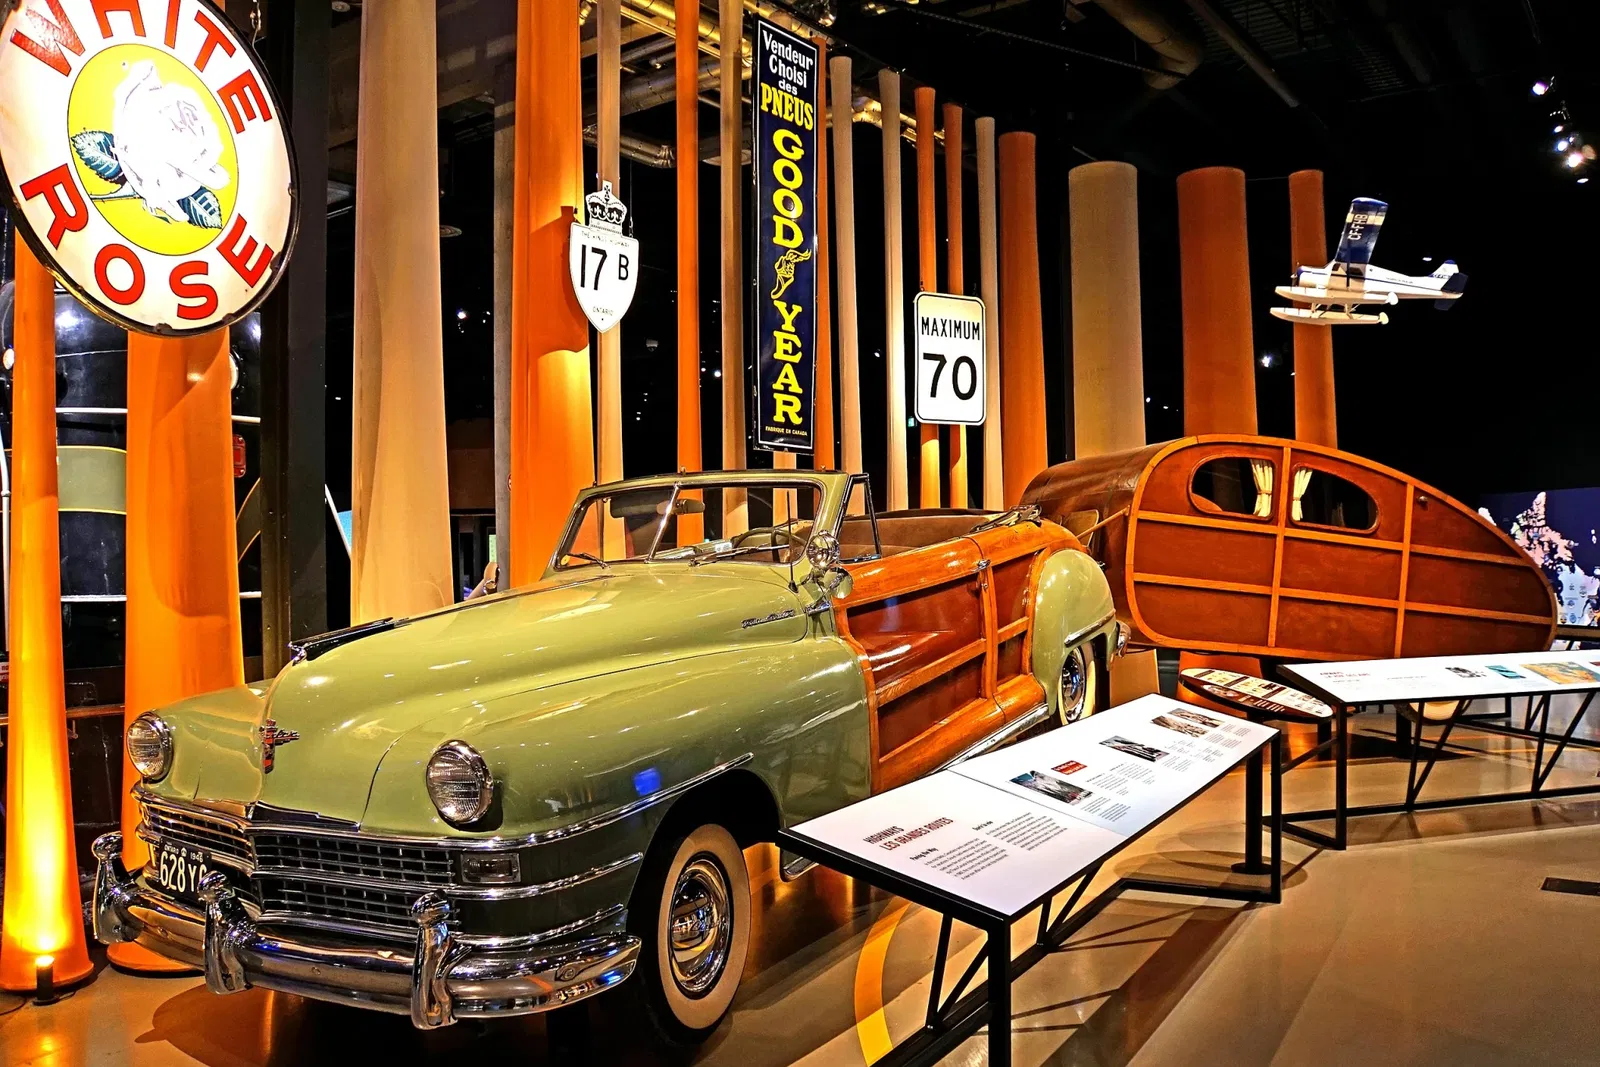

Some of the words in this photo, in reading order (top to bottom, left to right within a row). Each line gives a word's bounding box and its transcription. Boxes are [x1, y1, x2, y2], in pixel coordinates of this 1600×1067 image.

[10, 0, 273, 134] WHITE
[762, 29, 814, 70] Vendeur
[769, 54, 807, 88] Choisi
[778, 79, 798, 96] des
[760, 82, 814, 131] PNEUS
[20, 163, 275, 321] ROSE
[1347, 213, 1369, 241] CF-FHB
[580, 244, 608, 291] 17
[618, 253, 630, 281] B
[592, 306, 614, 317] ONTARIO
[921, 316, 981, 341] MAXIMUM
[922, 352, 978, 401] 70
[862, 826, 904, 844] HIGHWAYS
[879, 840, 900, 851] LES
[923, 816, 954, 831] ROUTES
